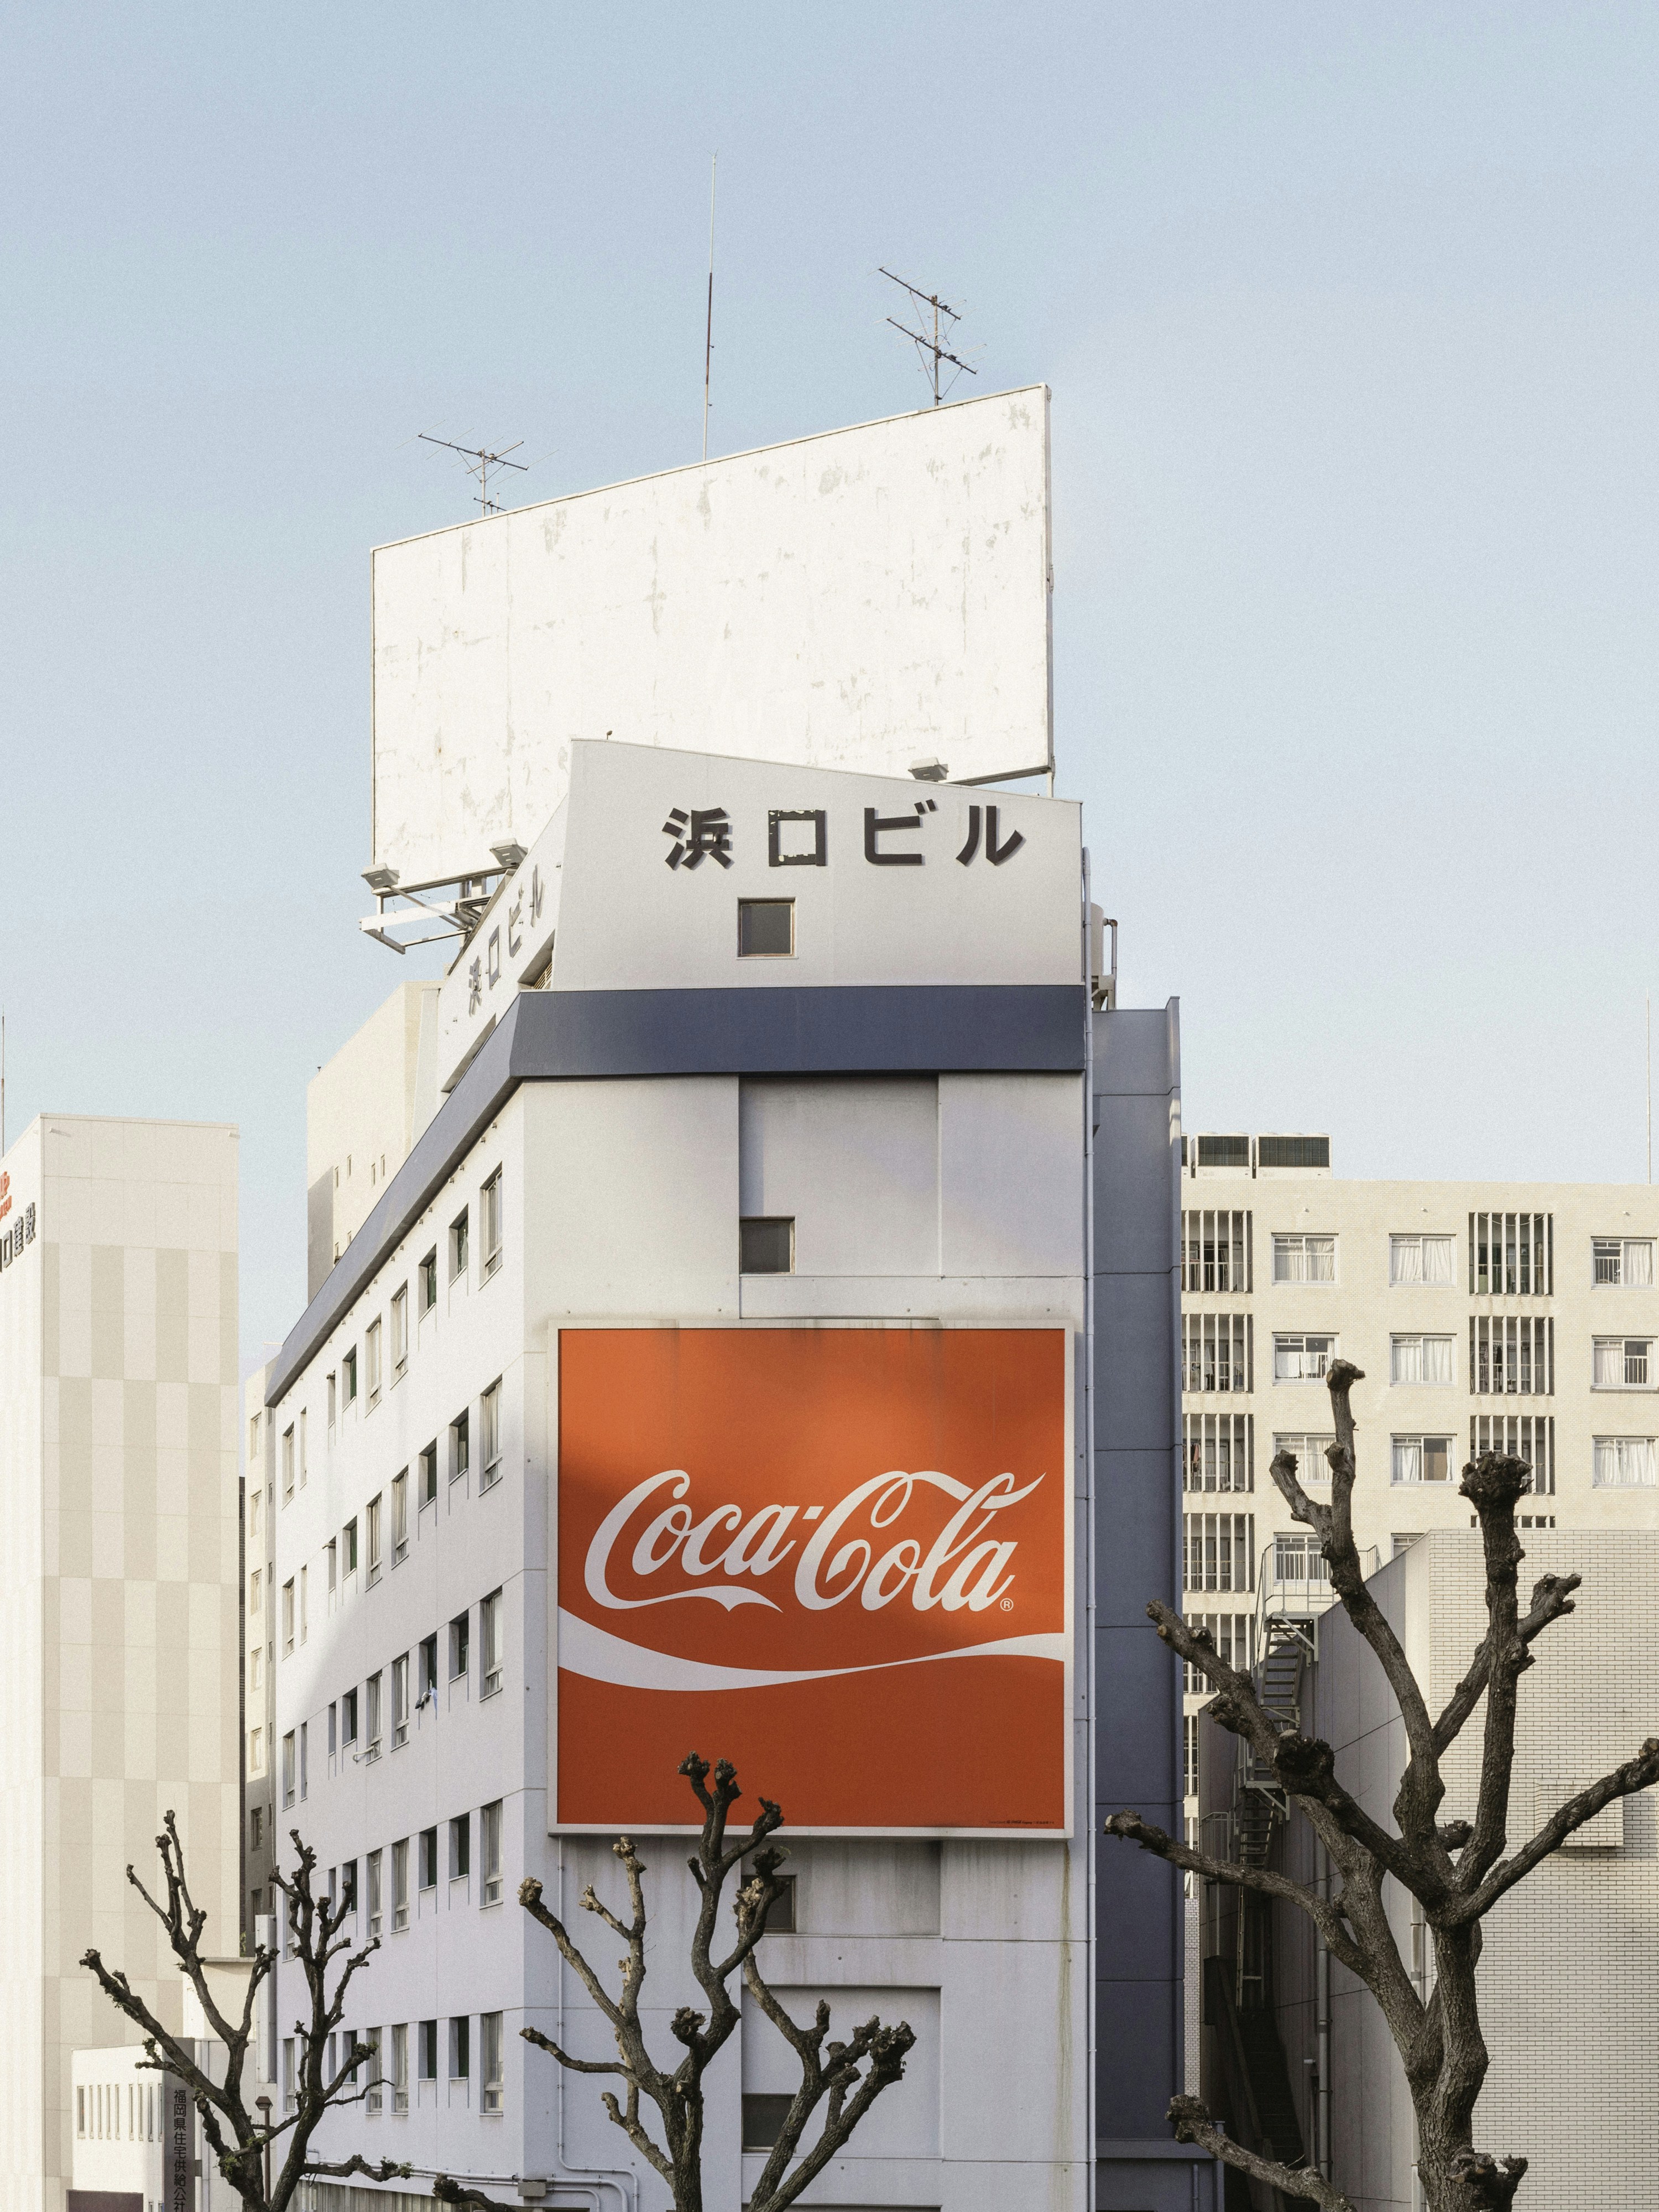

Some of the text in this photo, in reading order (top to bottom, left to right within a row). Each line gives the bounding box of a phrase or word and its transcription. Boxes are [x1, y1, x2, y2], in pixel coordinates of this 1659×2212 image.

[662, 799, 1024, 870] 浜口ビル
[468, 863, 545, 1017] 浜口ビル
[0, 1202, 35, 1272] 口建設
[585, 1469, 1046, 1614] Coca-Cola
[174, 2089, 187, 2212] 福岡県住宅供給公社
